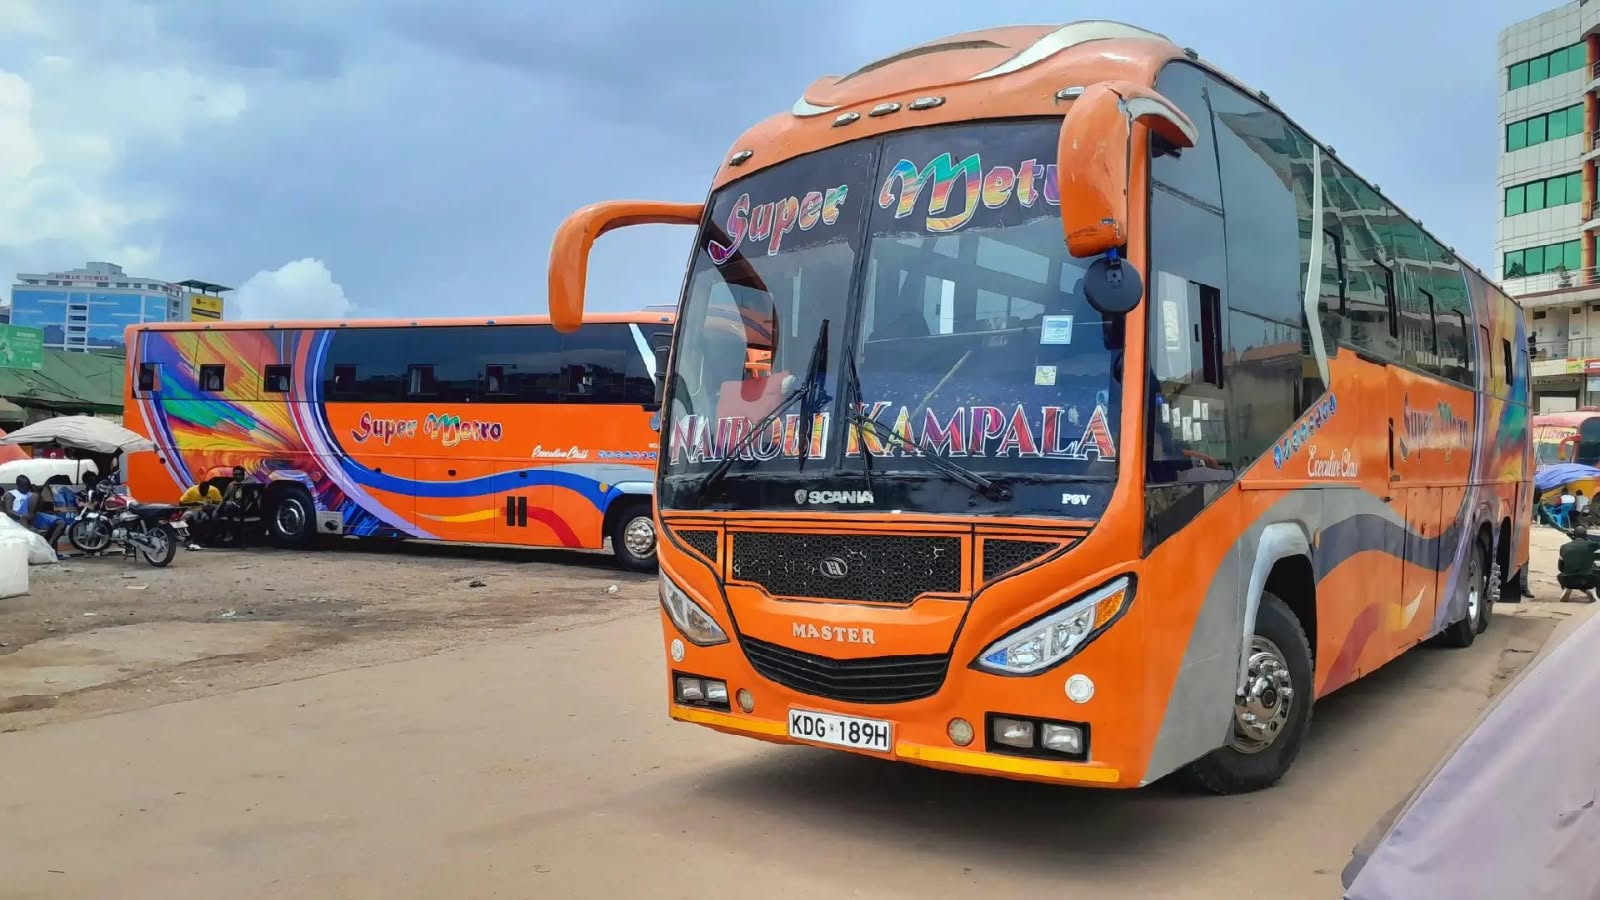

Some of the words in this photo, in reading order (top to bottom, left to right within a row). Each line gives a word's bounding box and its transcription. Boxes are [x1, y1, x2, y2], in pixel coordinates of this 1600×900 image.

[707, 184, 848, 265] Super
[351, 411, 417, 446] Super
[423, 412, 503, 447] Metro
[669, 412, 830, 465] NAIROBI
[845, 401, 1116, 461] KAMPALA
[809, 490, 874, 504] SCANIA
[1061, 493, 1091, 505] PSV
[792, 622, 876, 645] MASTER
[791, 713, 826, 738] KDG
[839, 721, 888, 748] 189H
